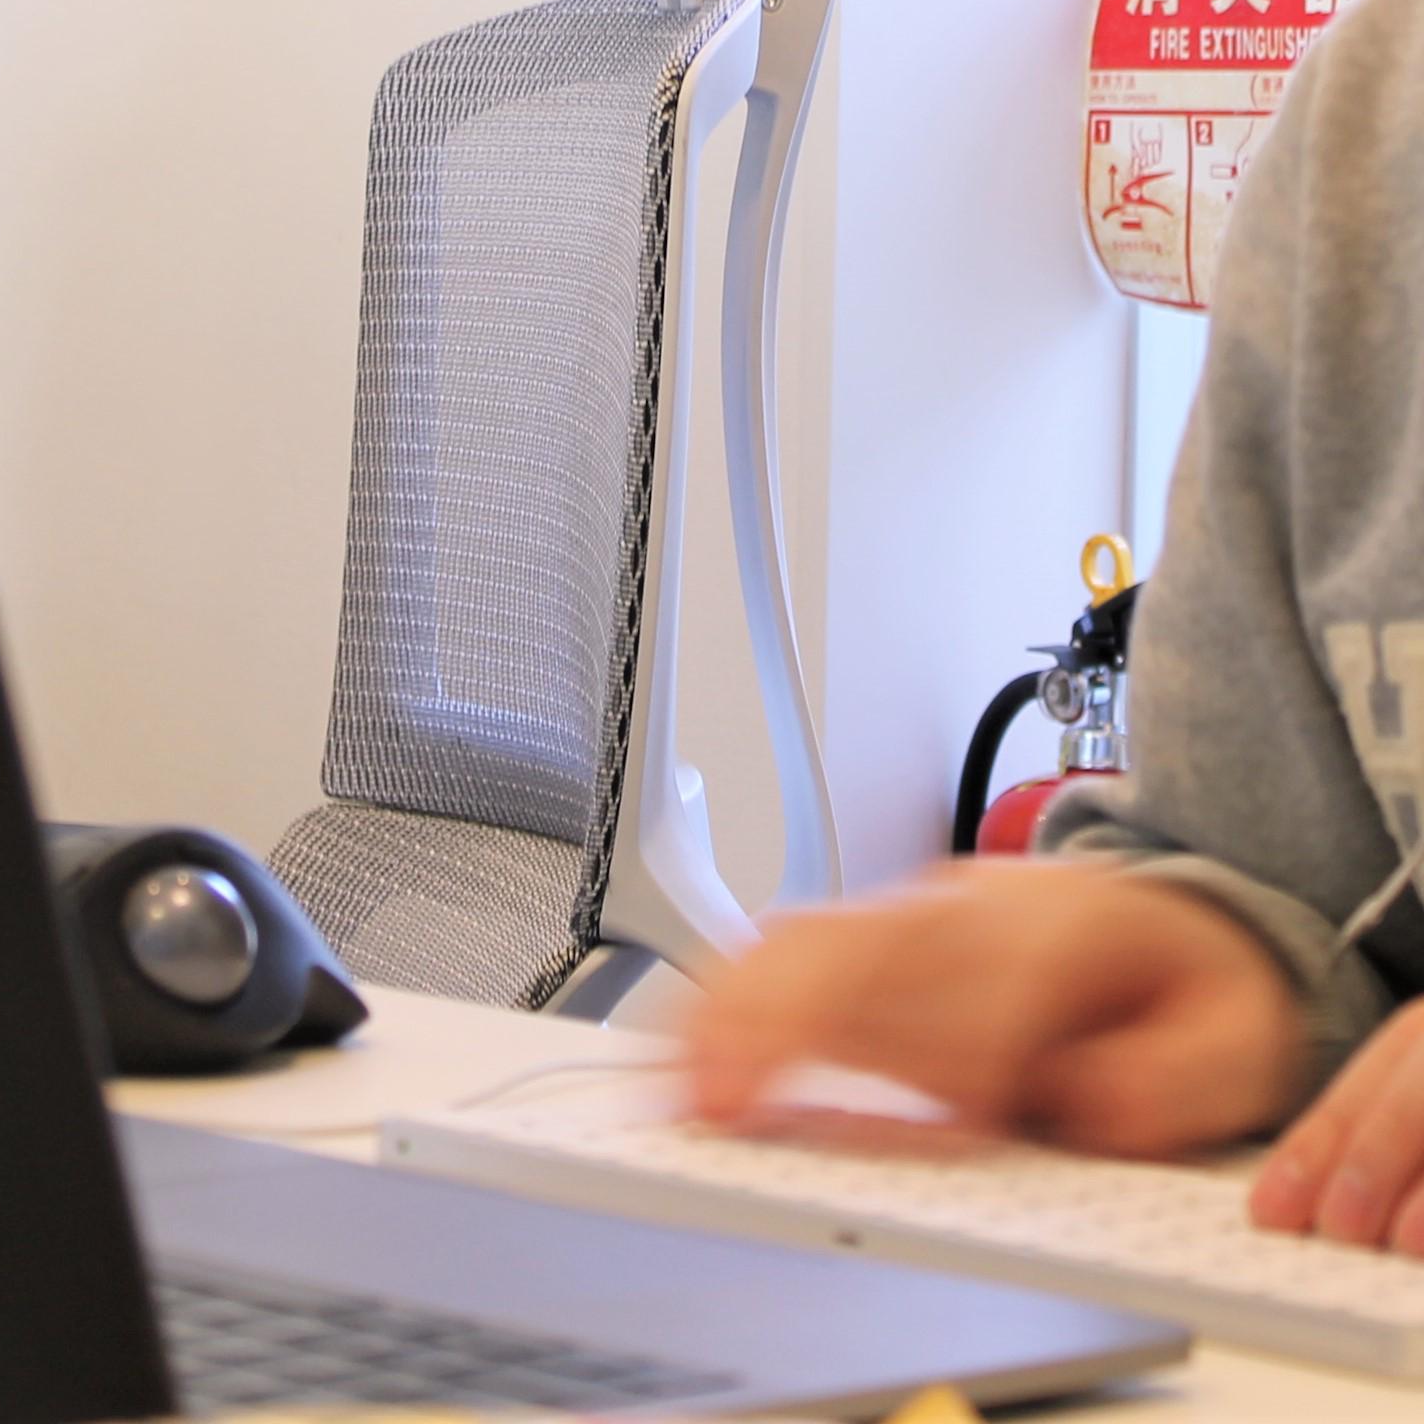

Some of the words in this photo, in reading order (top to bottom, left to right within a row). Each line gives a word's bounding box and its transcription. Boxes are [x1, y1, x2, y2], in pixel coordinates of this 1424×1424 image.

[1149, 26, 1191, 61] FIRE
[1199, 26, 1328, 61] EXTINGUISH
[1198, 122, 1211, 144] 2
